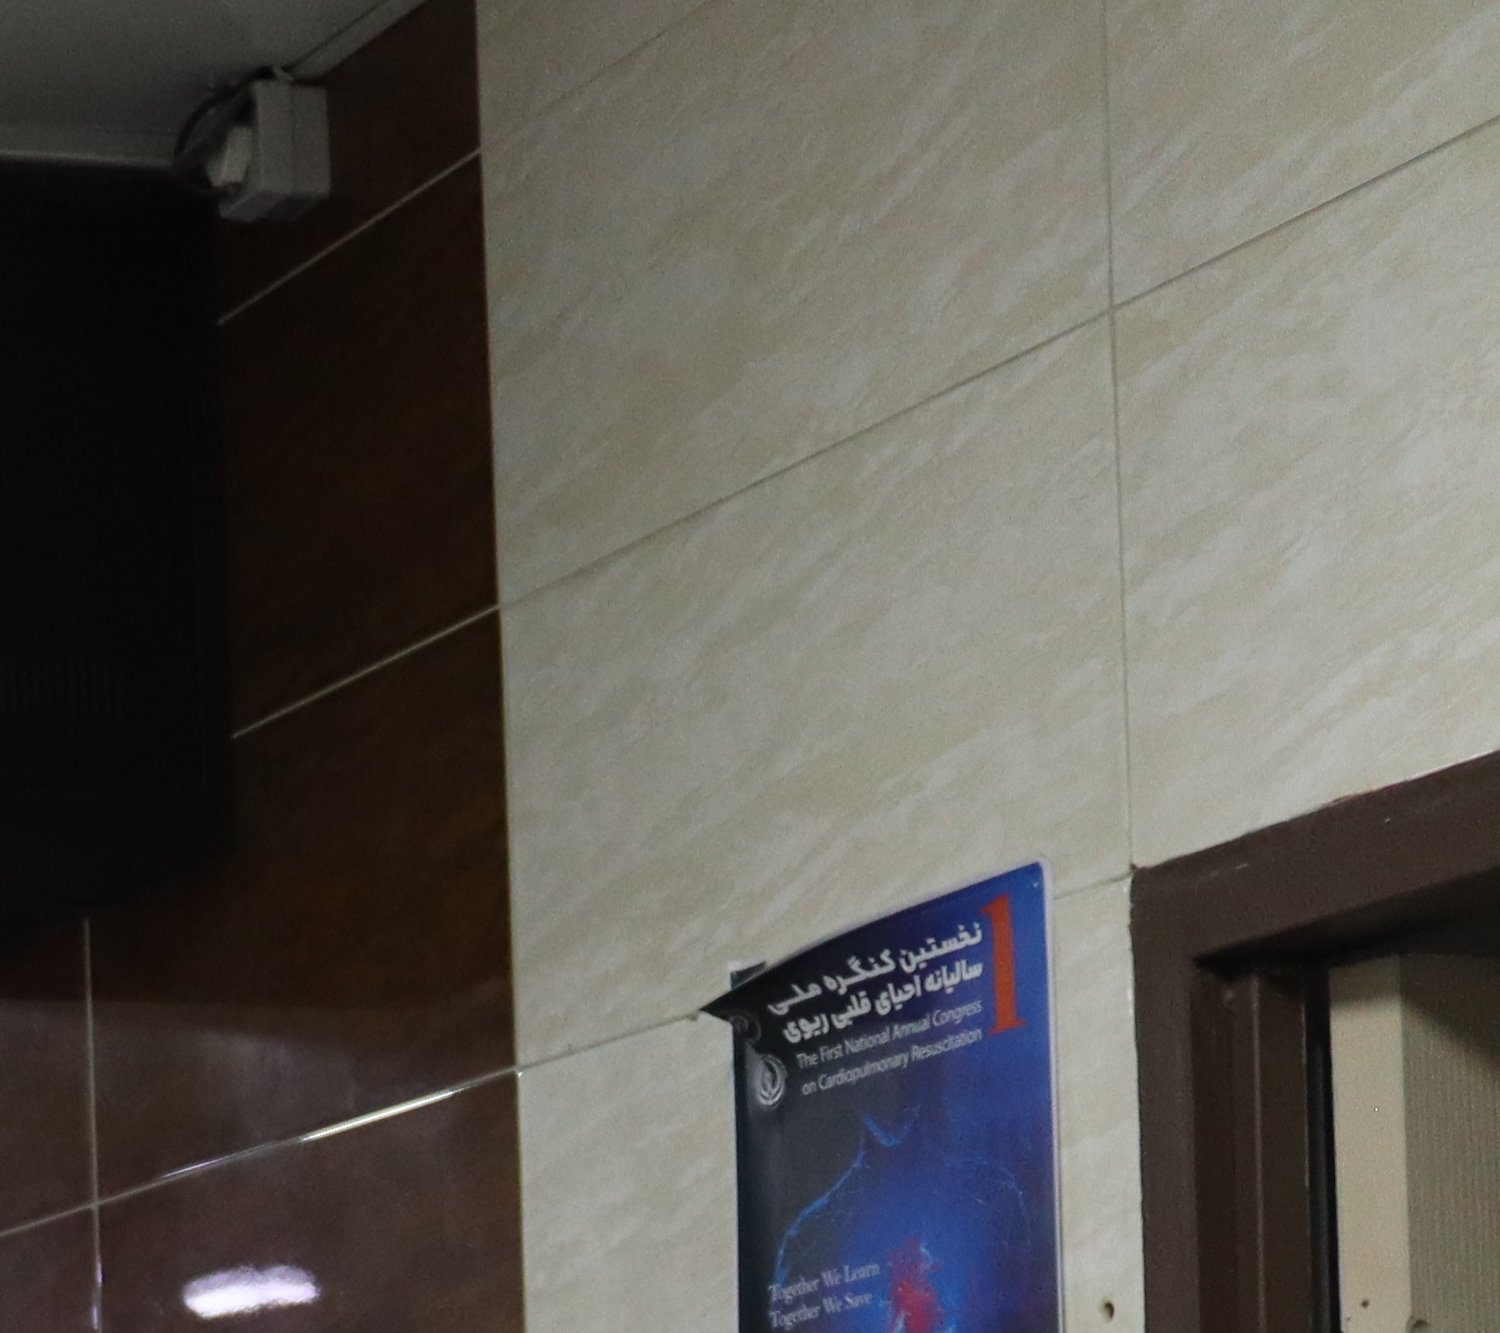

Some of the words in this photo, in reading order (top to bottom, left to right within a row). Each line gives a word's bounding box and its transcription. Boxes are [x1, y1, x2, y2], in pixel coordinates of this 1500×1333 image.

[899, 922, 983, 973] نخستین
[823, 950, 896, 996] کنگره
[924, 959, 983, 995] سالیانه
[767, 983, 822, 1016] ملی
[830, 991, 872, 1030] قلبی
[874, 974, 922, 1016] احیای
[782, 1013, 830, 1043] ریوی
[796, 1053, 819, 1069] The
[819, 1044, 844, 1062] First
[843, 1026, 891, 1056] National
[892, 1014, 931, 1043] Annual
[931, 1000, 983, 1030] Congress
[802, 1080, 818, 1096] on
[819, 1051, 910, 1090] Cardiopulmonary
[910, 1028, 983, 1064] Resuscitation
[768, 1277, 820, 1304] Together
[821, 1268, 842, 1287] We
[769, 1304, 820, 1330] Together
[822, 1296, 843, 1314] We
